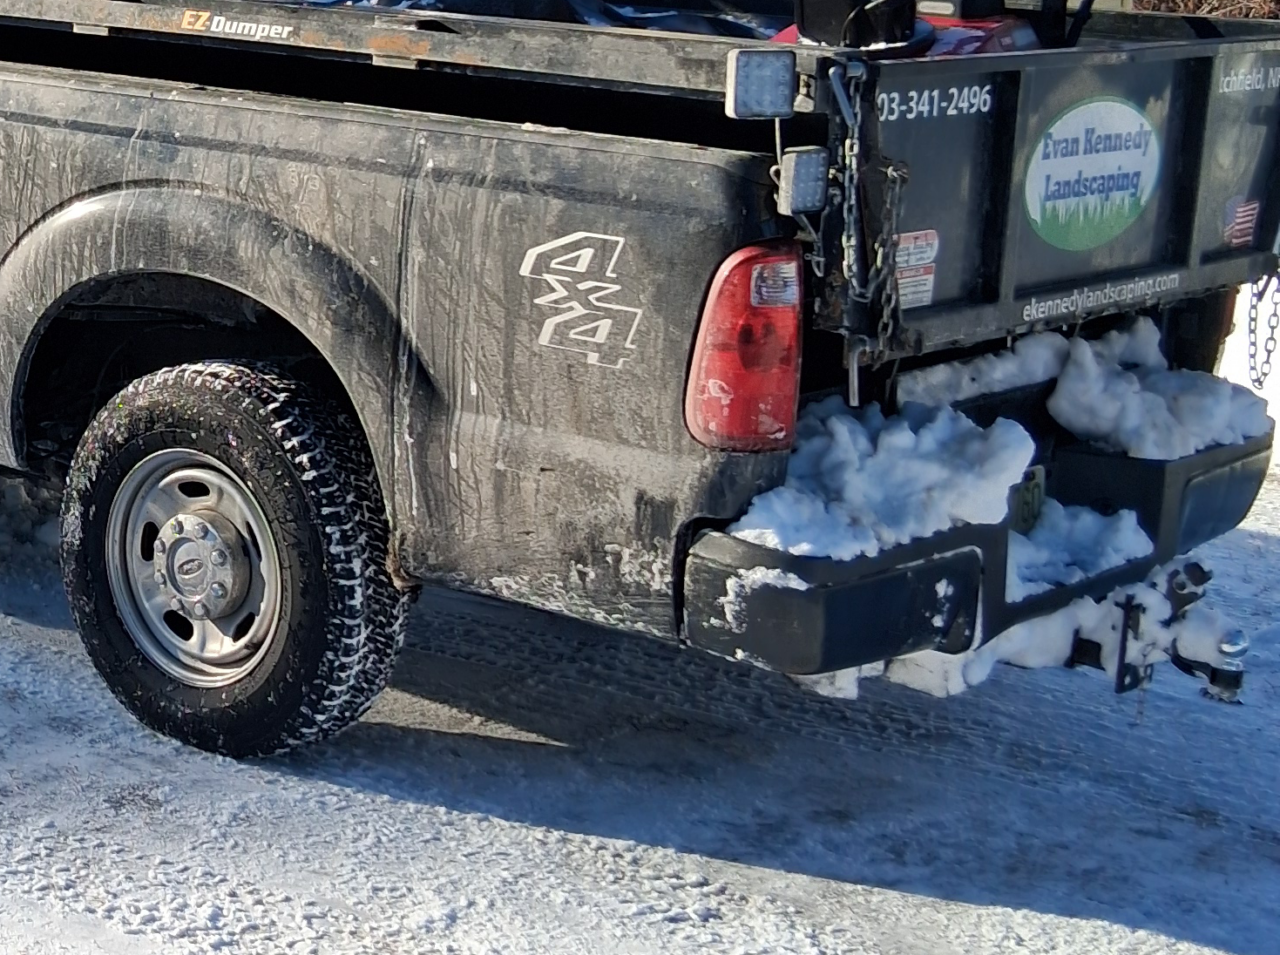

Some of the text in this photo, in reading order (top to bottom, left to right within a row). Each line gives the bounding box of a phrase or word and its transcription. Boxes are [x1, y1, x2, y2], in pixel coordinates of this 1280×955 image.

[181, 9, 294, 40] EZ-Dumper
[1218, 67, 1266, 93] tchfield,
[877, 84, 992, 122] 03-341-2496
[1041, 123, 1152, 161] Evan Kennedy
[1043, 165, 1142, 202] Landscaping
[1022, 273, 1180, 321] ekennedylandscaping.com
